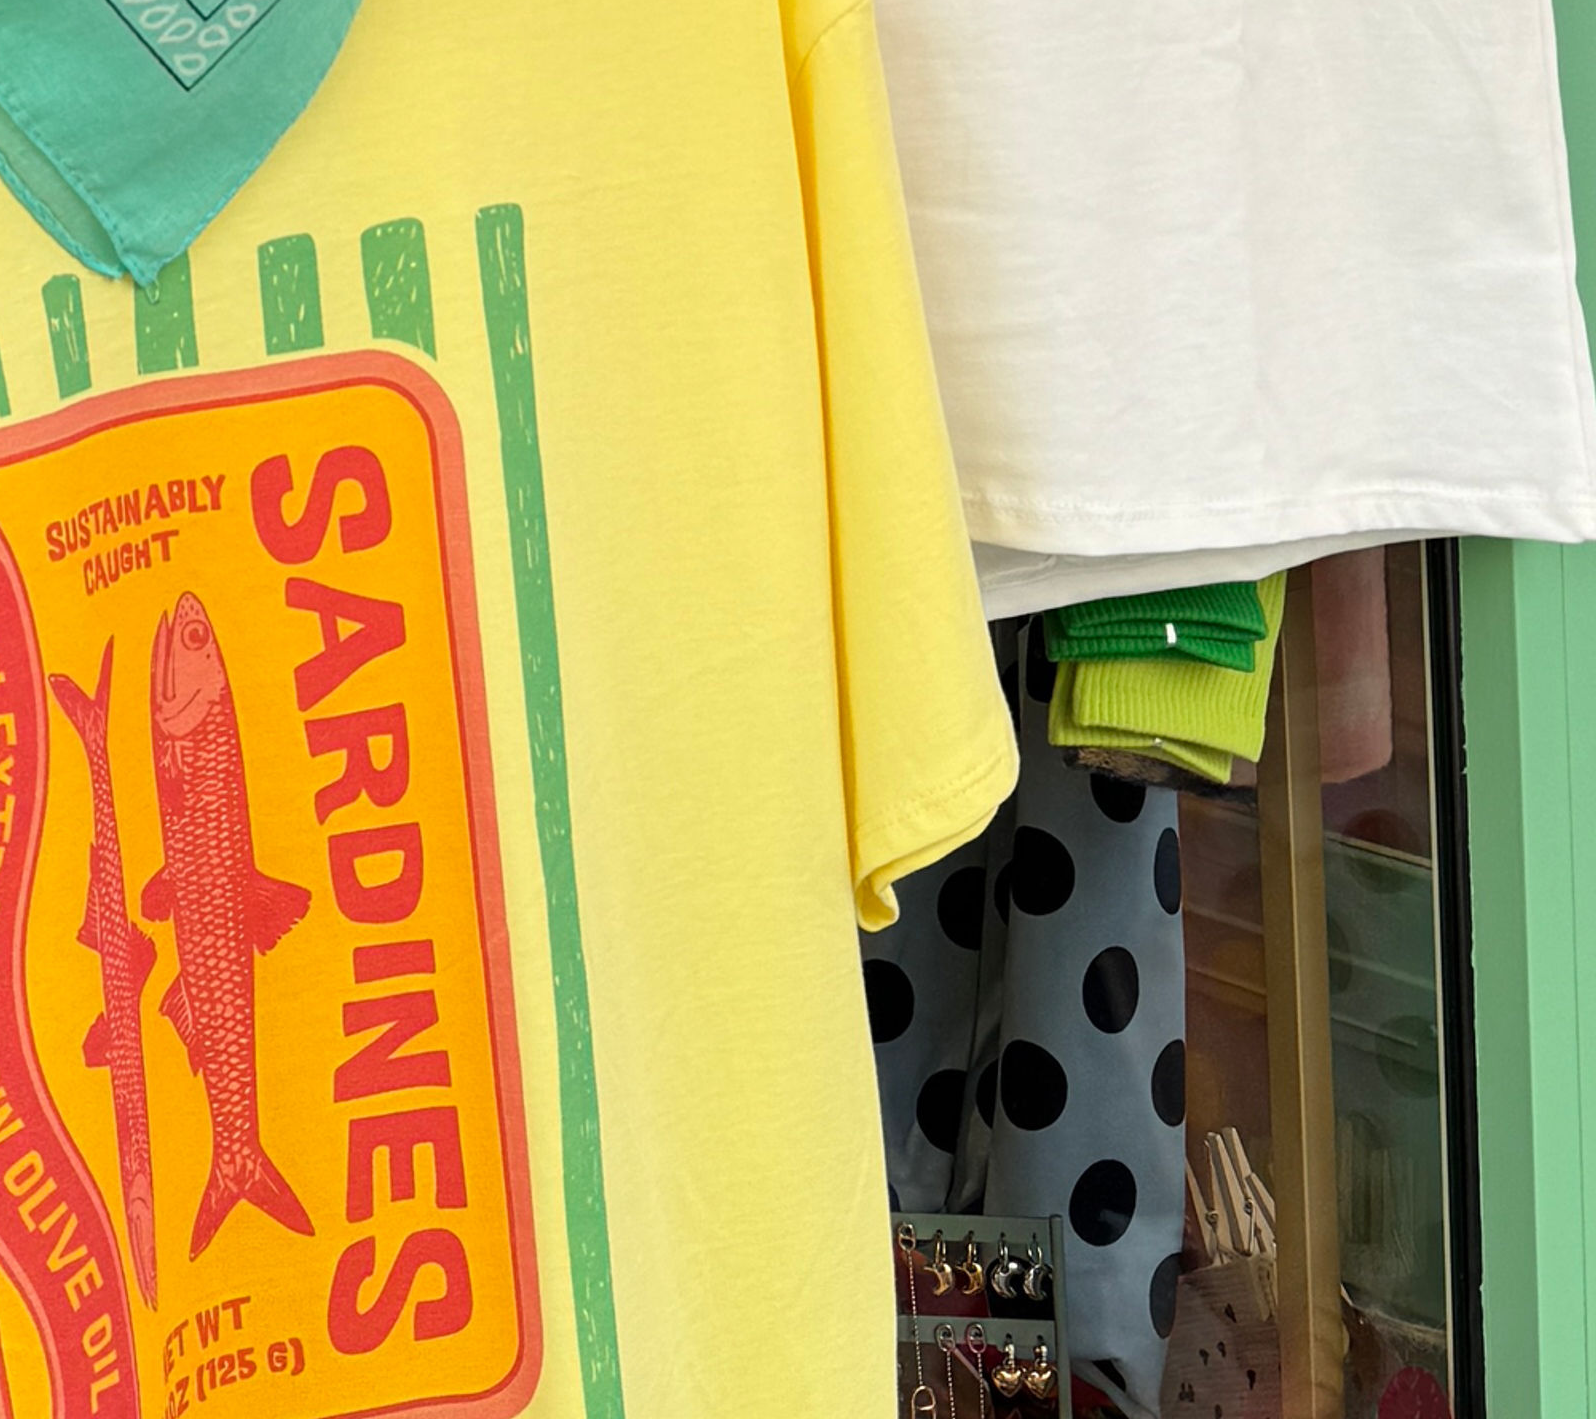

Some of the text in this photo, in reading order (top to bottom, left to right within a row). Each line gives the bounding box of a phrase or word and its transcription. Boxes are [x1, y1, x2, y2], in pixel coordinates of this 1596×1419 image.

[45, 473, 226, 563] SUSTAINABLY
[82, 528, 180, 597] CAUGHT
[249, 444, 474, 1357] SARDINES
[2, 1149, 104, 1313] OLIVE
[81, 1312, 120, 1415] OIL
[194, 1294, 252, 1351] WT
[195, 1346, 258, 1403] (125
[266, 1336, 306, 1377] G)
